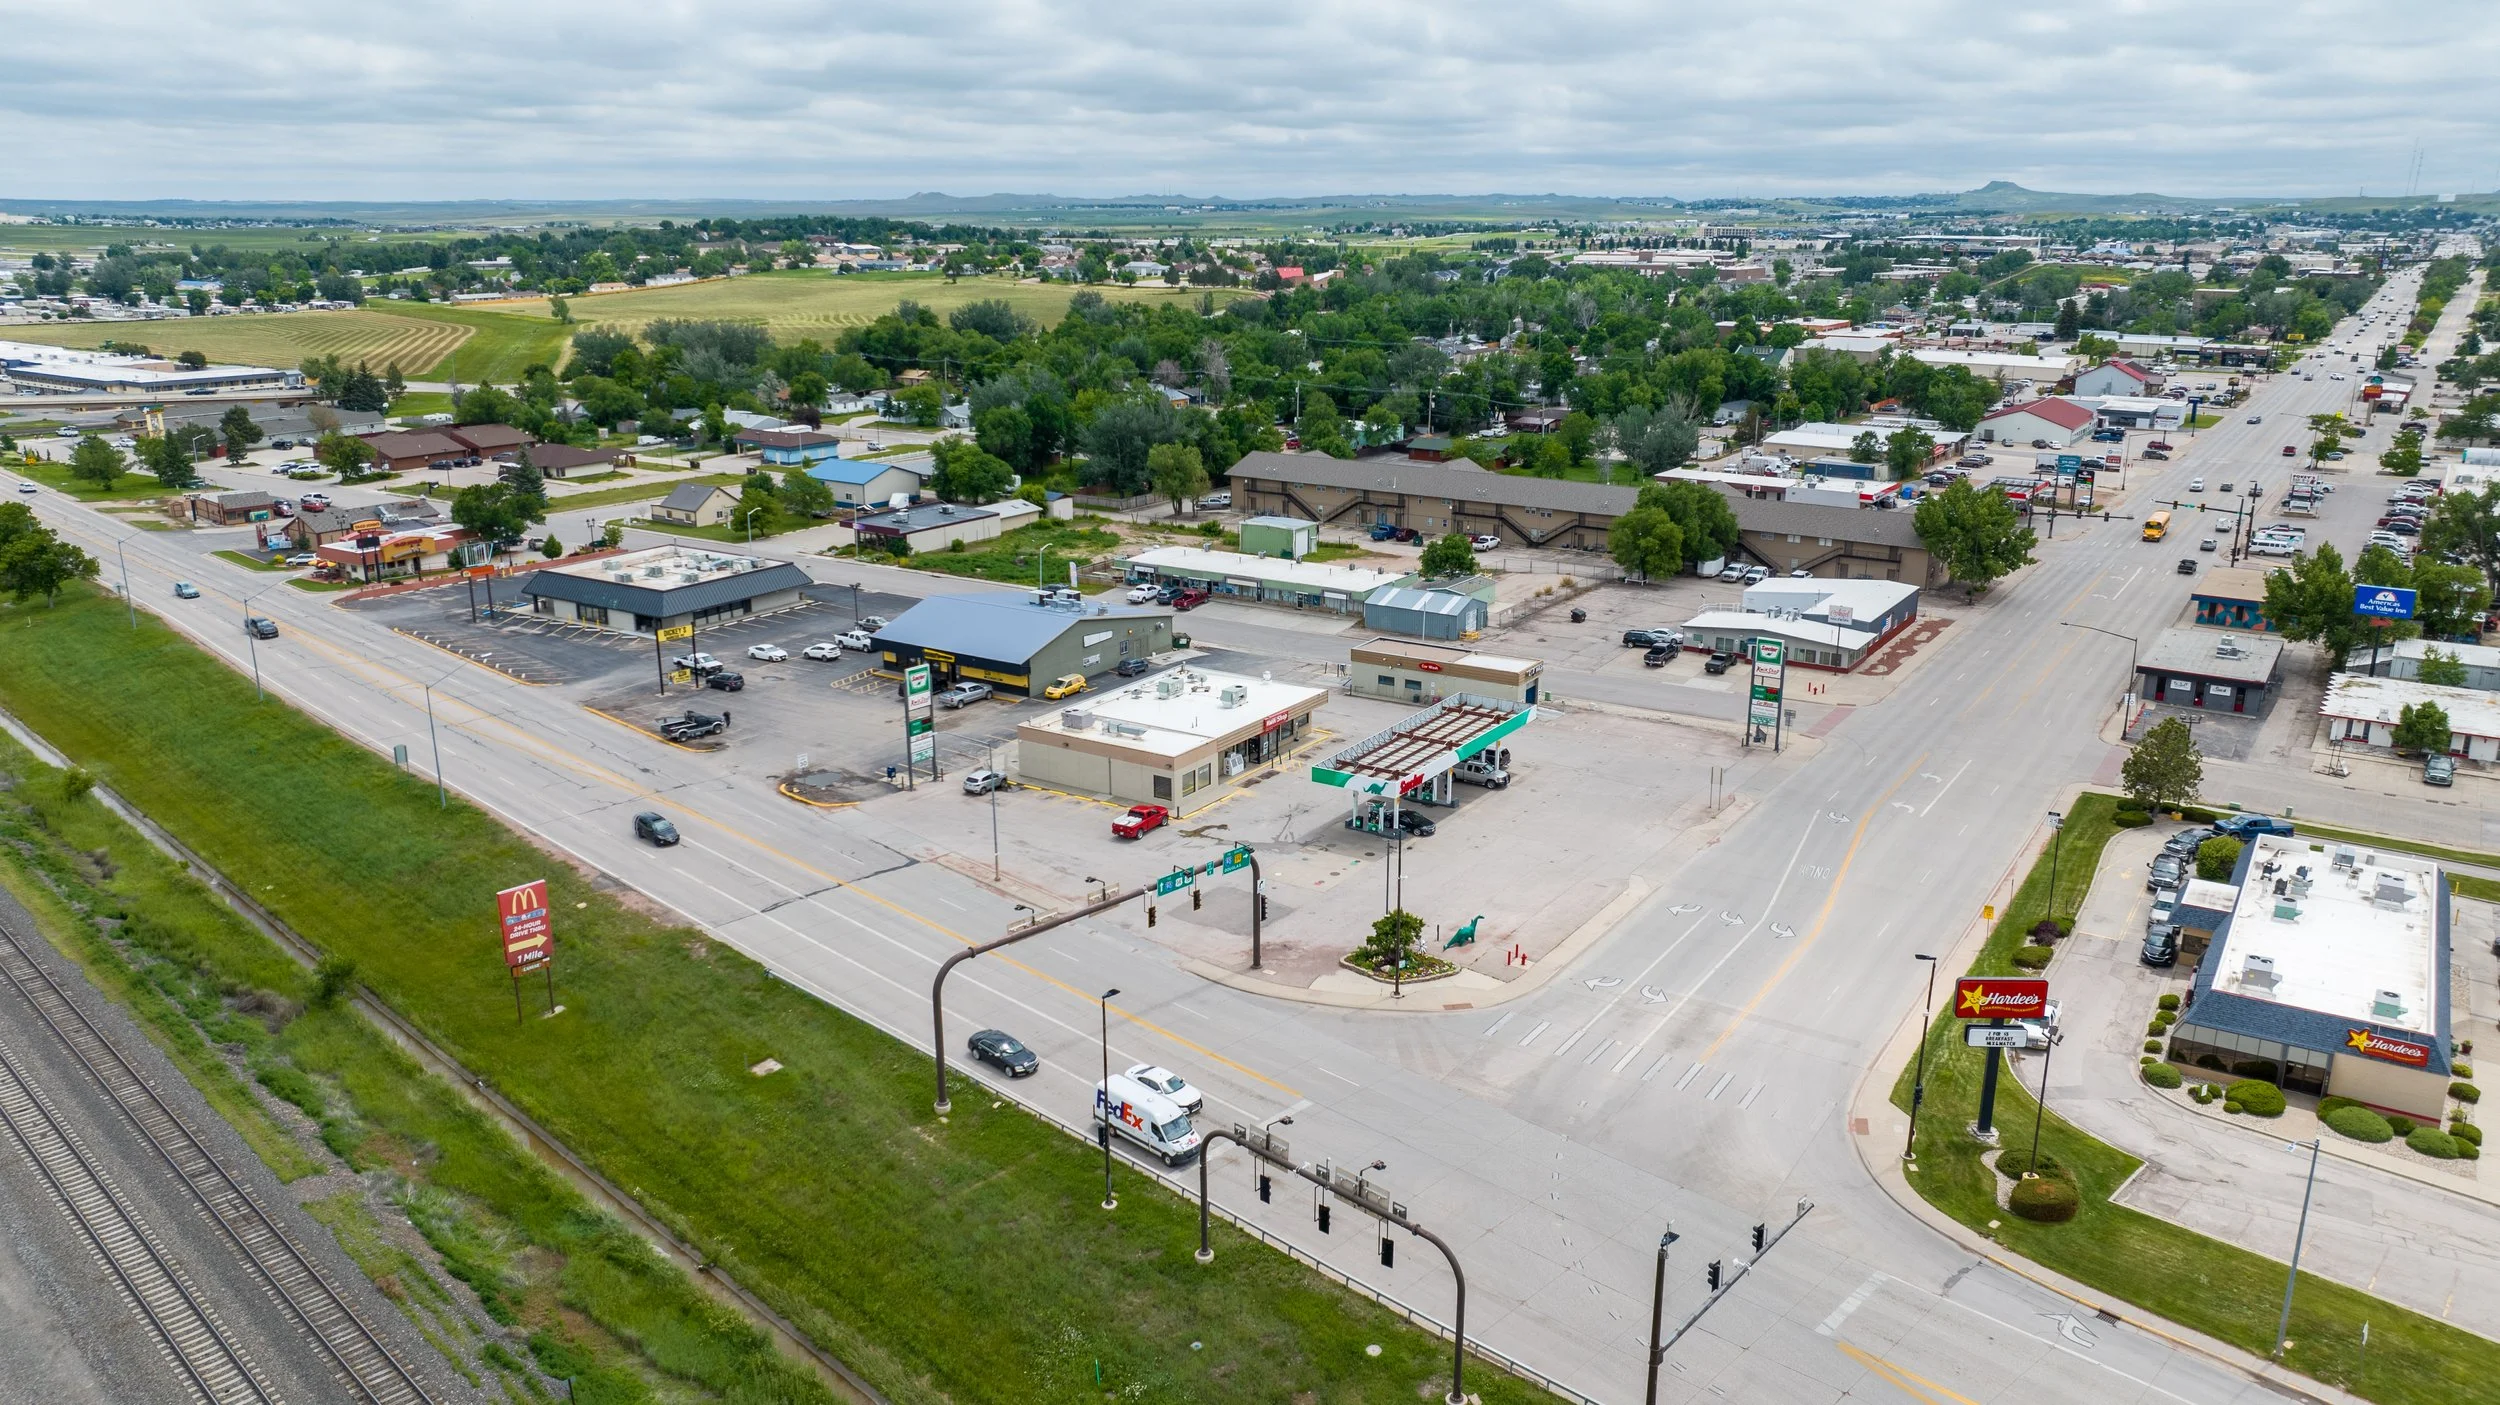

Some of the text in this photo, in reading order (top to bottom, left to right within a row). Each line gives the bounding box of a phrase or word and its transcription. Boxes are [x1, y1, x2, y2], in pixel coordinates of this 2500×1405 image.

[510, 924, 546, 939] DRIVE THRU
[514, 920, 542, 932] 24-HOUR
[518, 950, 544, 964] 1 Mile
[1978, 992, 2042, 1006] Hardee's
[2364, 1039, 2424, 1057] Hardee's
[1097, 1088, 1144, 1132] FedEx
